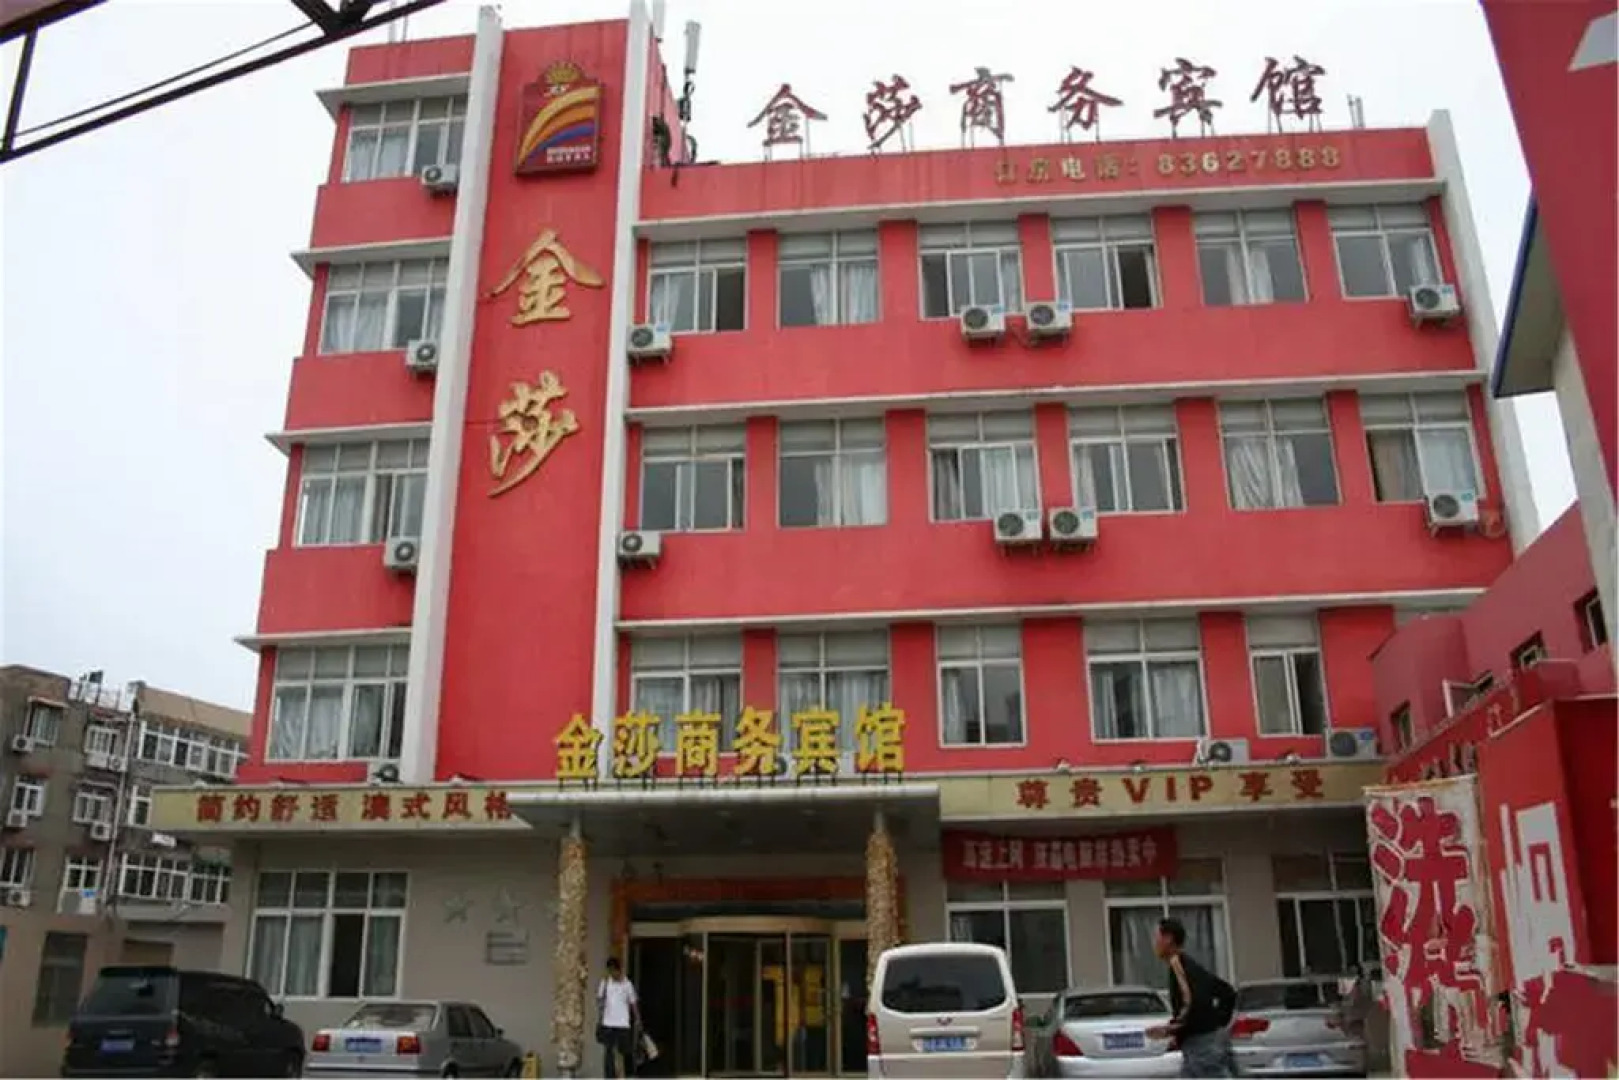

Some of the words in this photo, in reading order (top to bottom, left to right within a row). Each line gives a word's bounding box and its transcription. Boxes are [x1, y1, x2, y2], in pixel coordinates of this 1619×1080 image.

[746, 56, 1327, 148] 金莎商务宾馆
[1156, 144, 1342, 177] 83627888
[484, 229, 604, 498] 金莎
[554, 703, 906, 779] 金莎商务宾馆
[196, 793, 340, 823] 简约舒适
